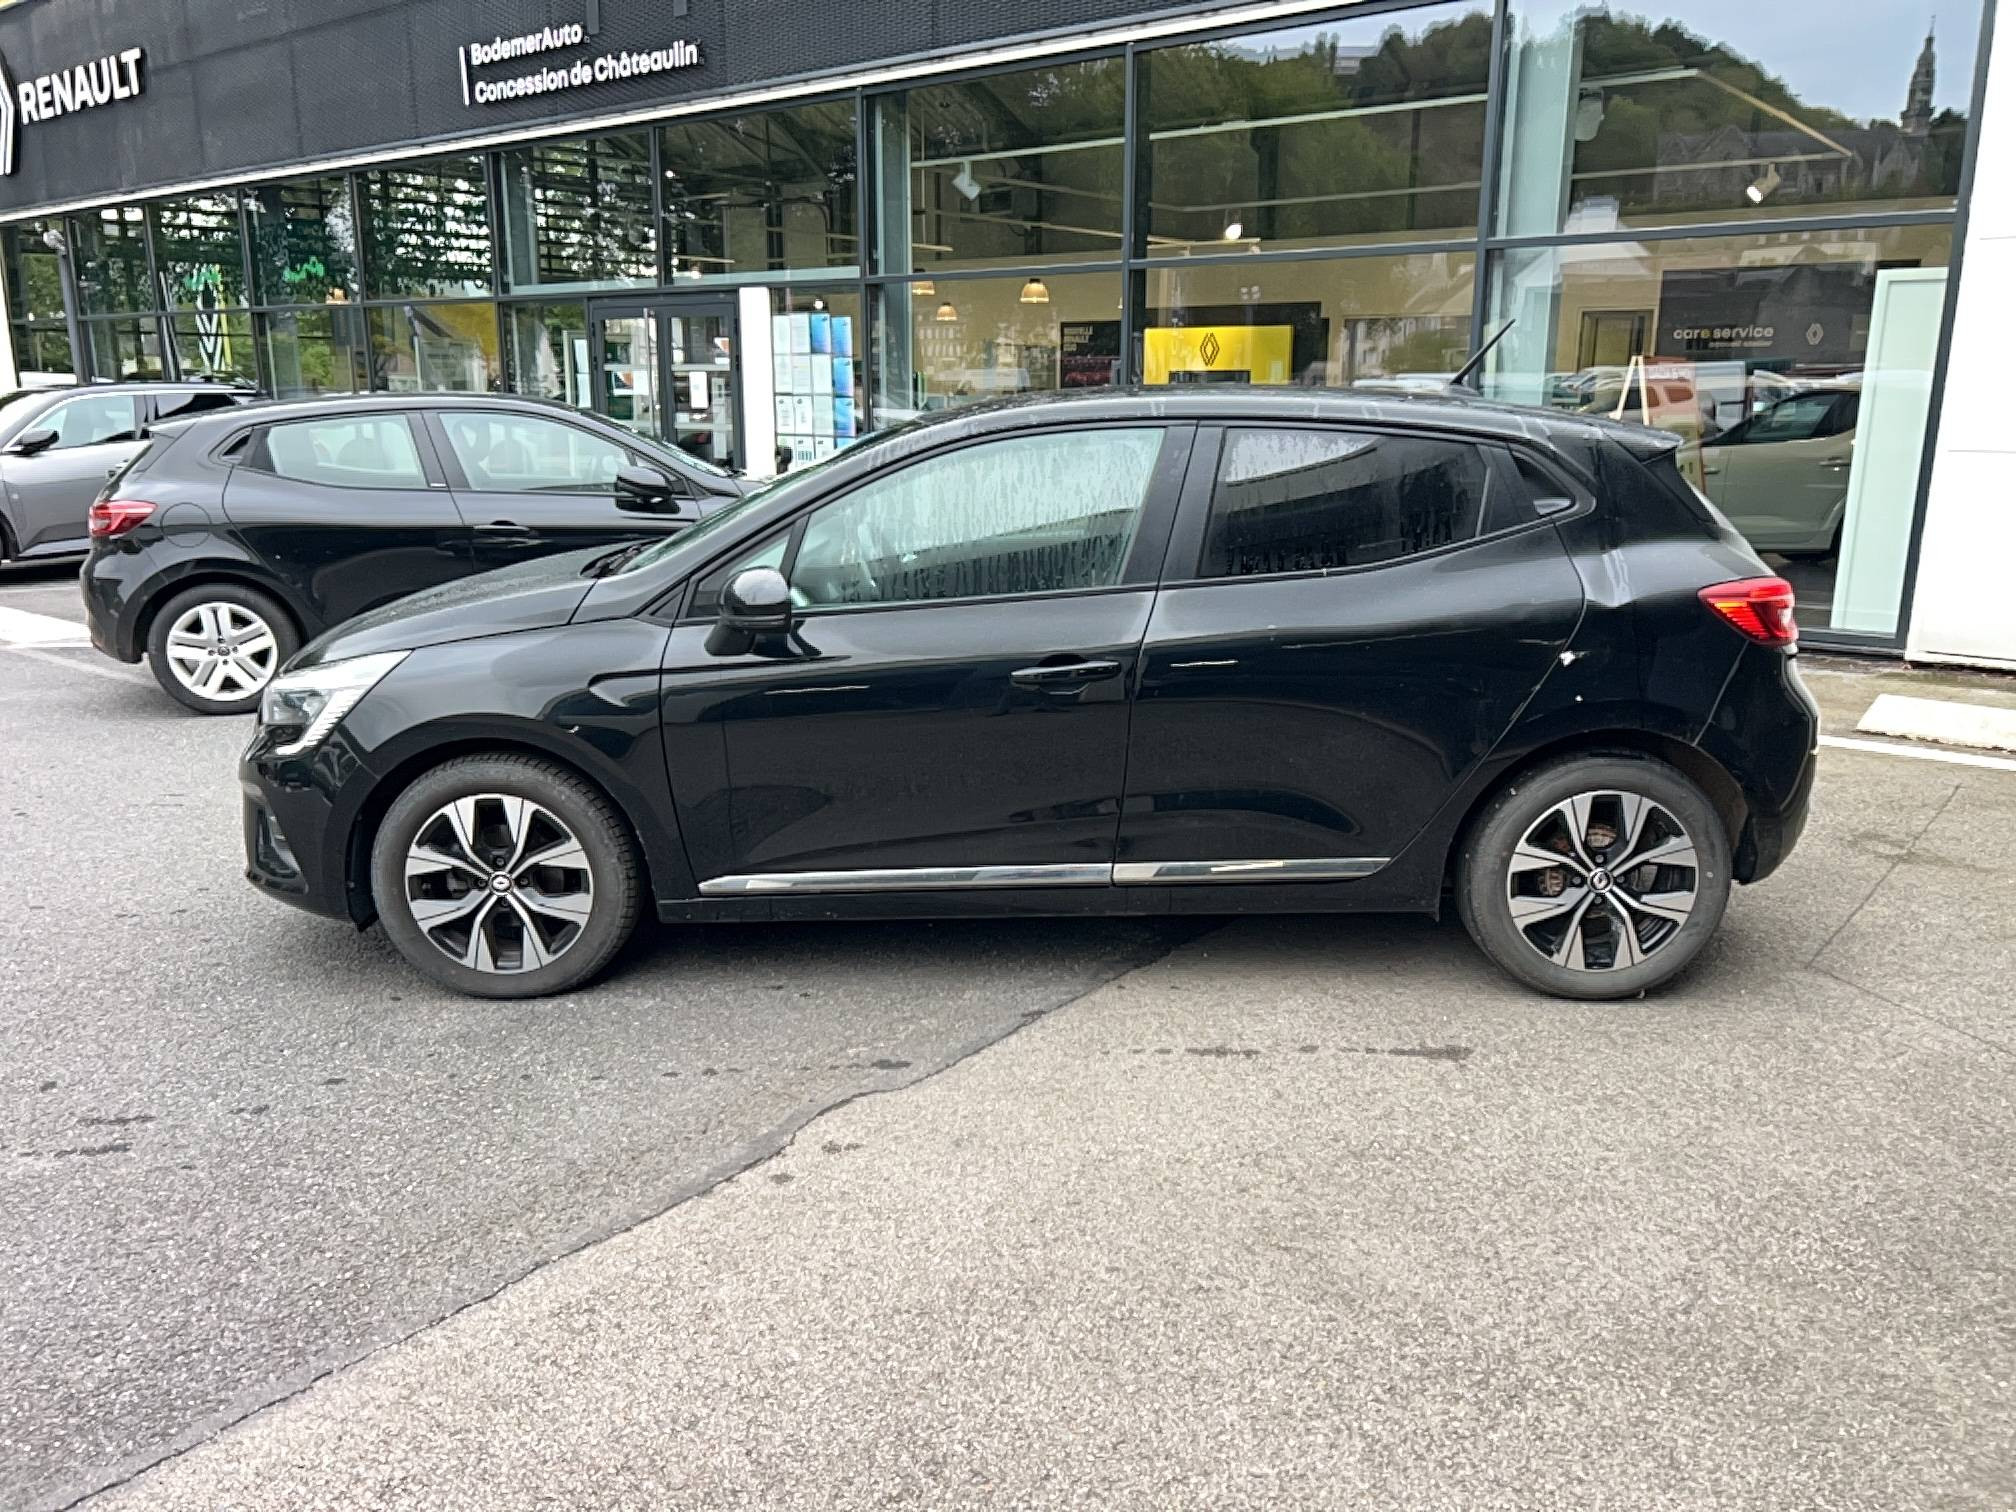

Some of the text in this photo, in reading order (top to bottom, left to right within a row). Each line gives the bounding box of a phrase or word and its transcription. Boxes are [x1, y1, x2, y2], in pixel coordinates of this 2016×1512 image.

[470, 22, 583, 66] BodemerAuto
[18, 47, 142, 126] RENAULT
[474, 40, 699, 104] Concession de Châteaulin
[1673, 324, 1775, 340] care service
